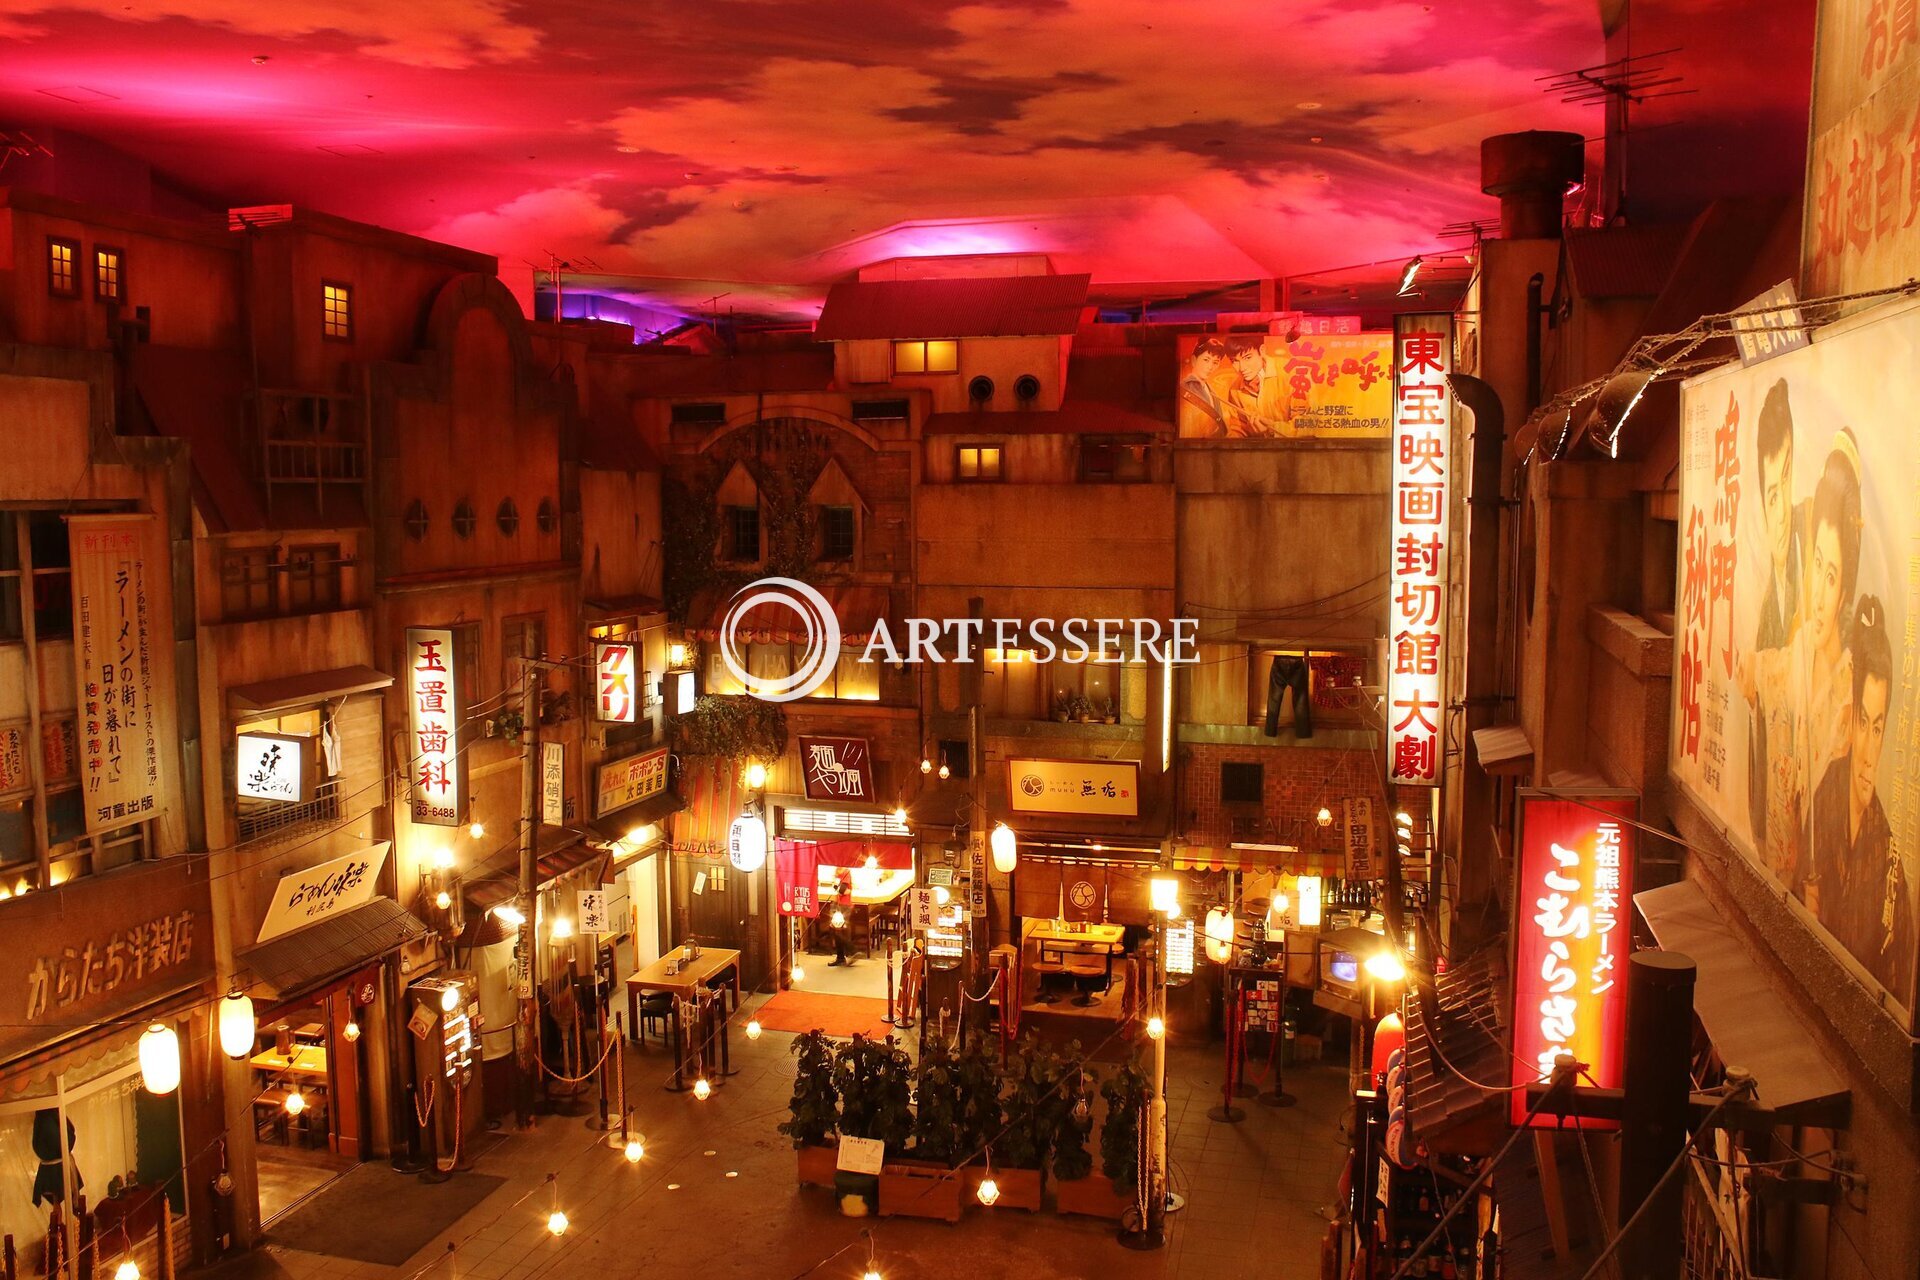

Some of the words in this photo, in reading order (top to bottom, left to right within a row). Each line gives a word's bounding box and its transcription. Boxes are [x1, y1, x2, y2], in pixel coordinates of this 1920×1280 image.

[415, 639, 452, 795] 玉置歯科
[601, 647, 629, 720] クスリ
[97, 795, 155, 822] 河童出版
[416, 806, 455, 818] 33-6488
[545, 747, 560, 813] 川添硝子
[1591, 822, 1621, 996] 元祖熊本ラーメン
[26, 909, 195, 1021] からたち洋装店
